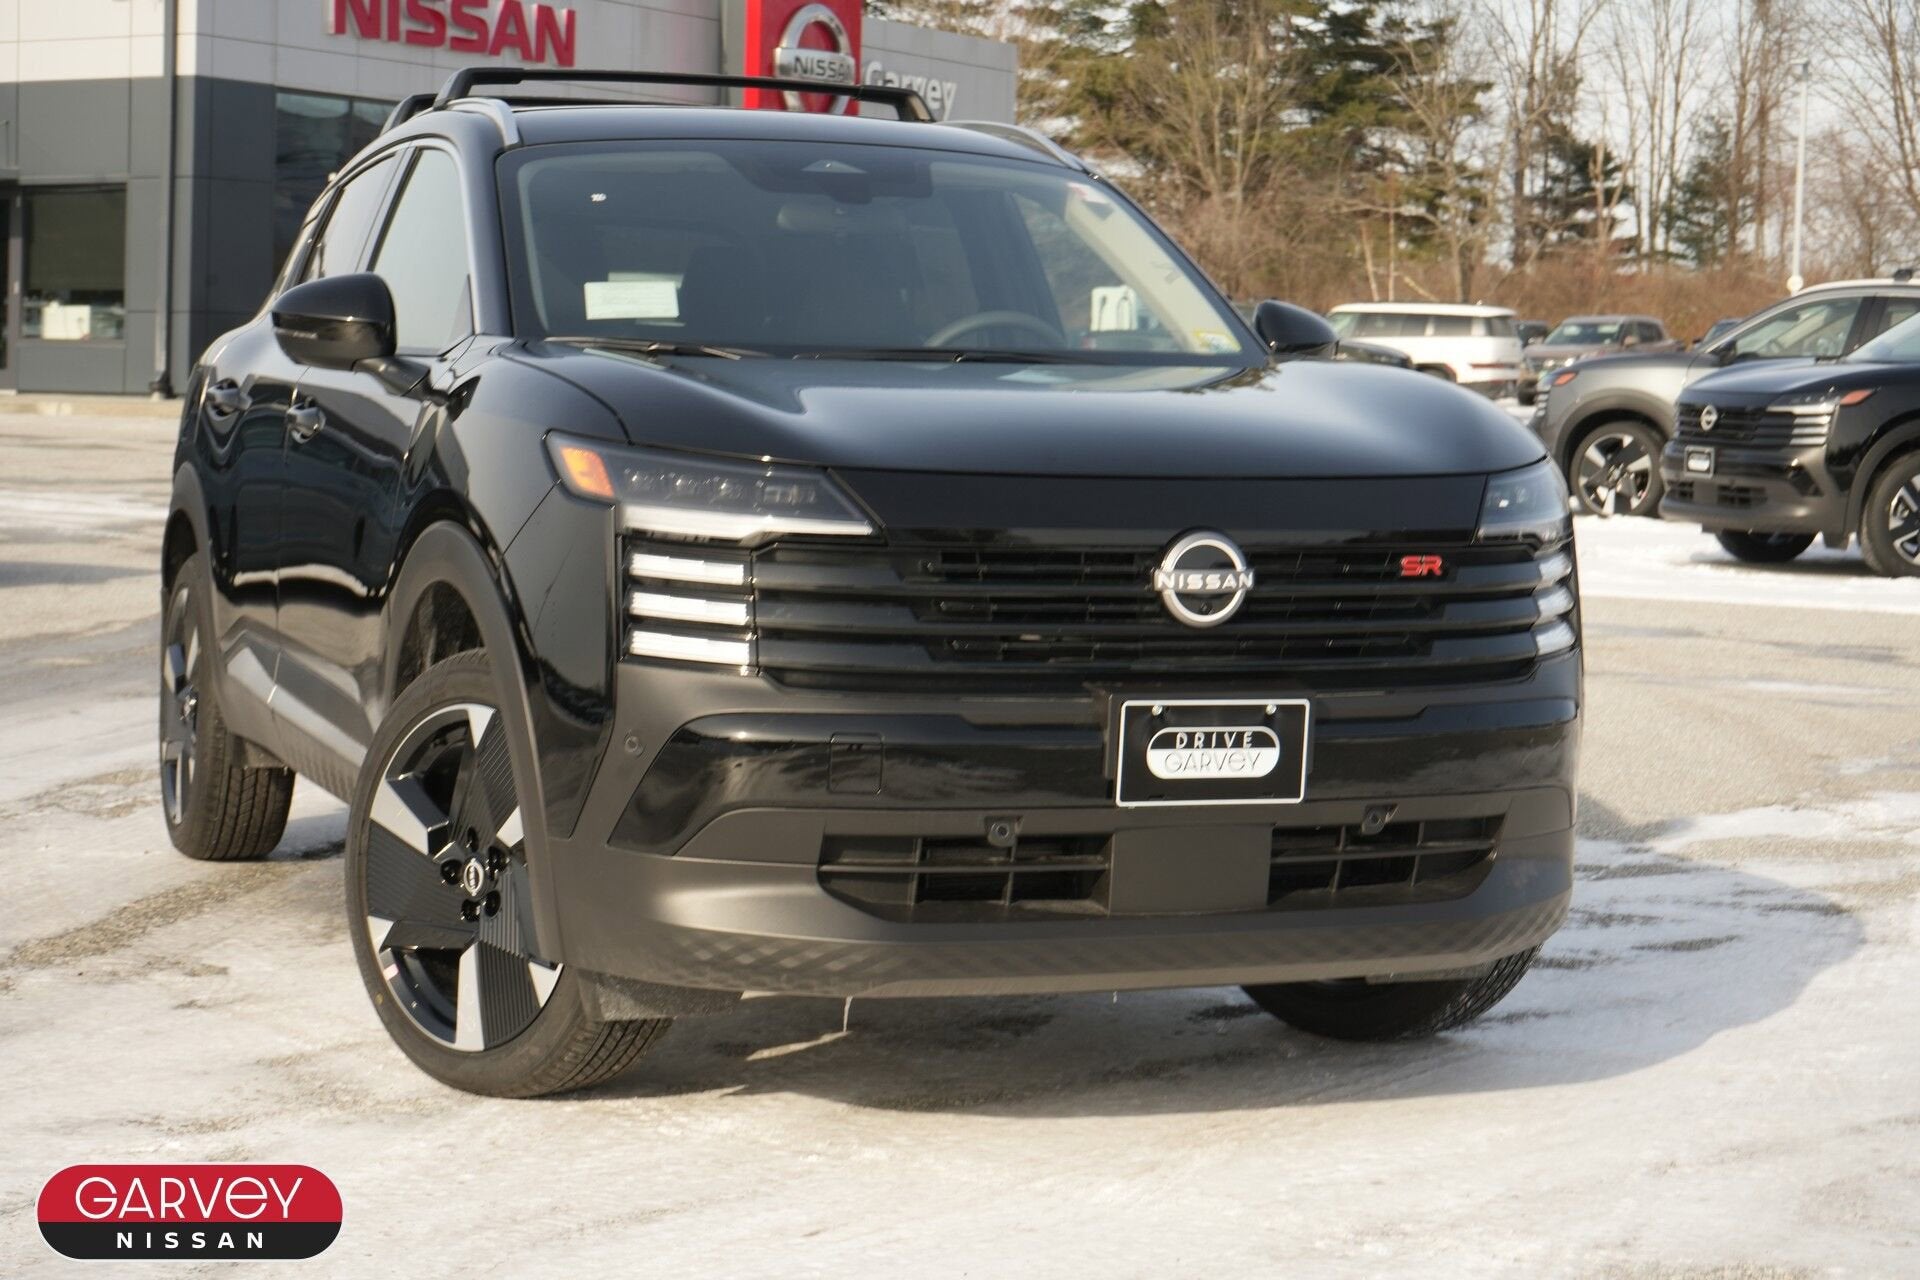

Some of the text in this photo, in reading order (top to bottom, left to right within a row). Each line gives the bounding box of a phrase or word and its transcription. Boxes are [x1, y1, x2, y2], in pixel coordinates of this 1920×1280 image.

[330, 0, 576, 68] NISSAN
[1400, 555, 1442, 577] SR
[1157, 571, 1253, 590] NISSAN
[1175, 730, 1253, 749] DRIVE
